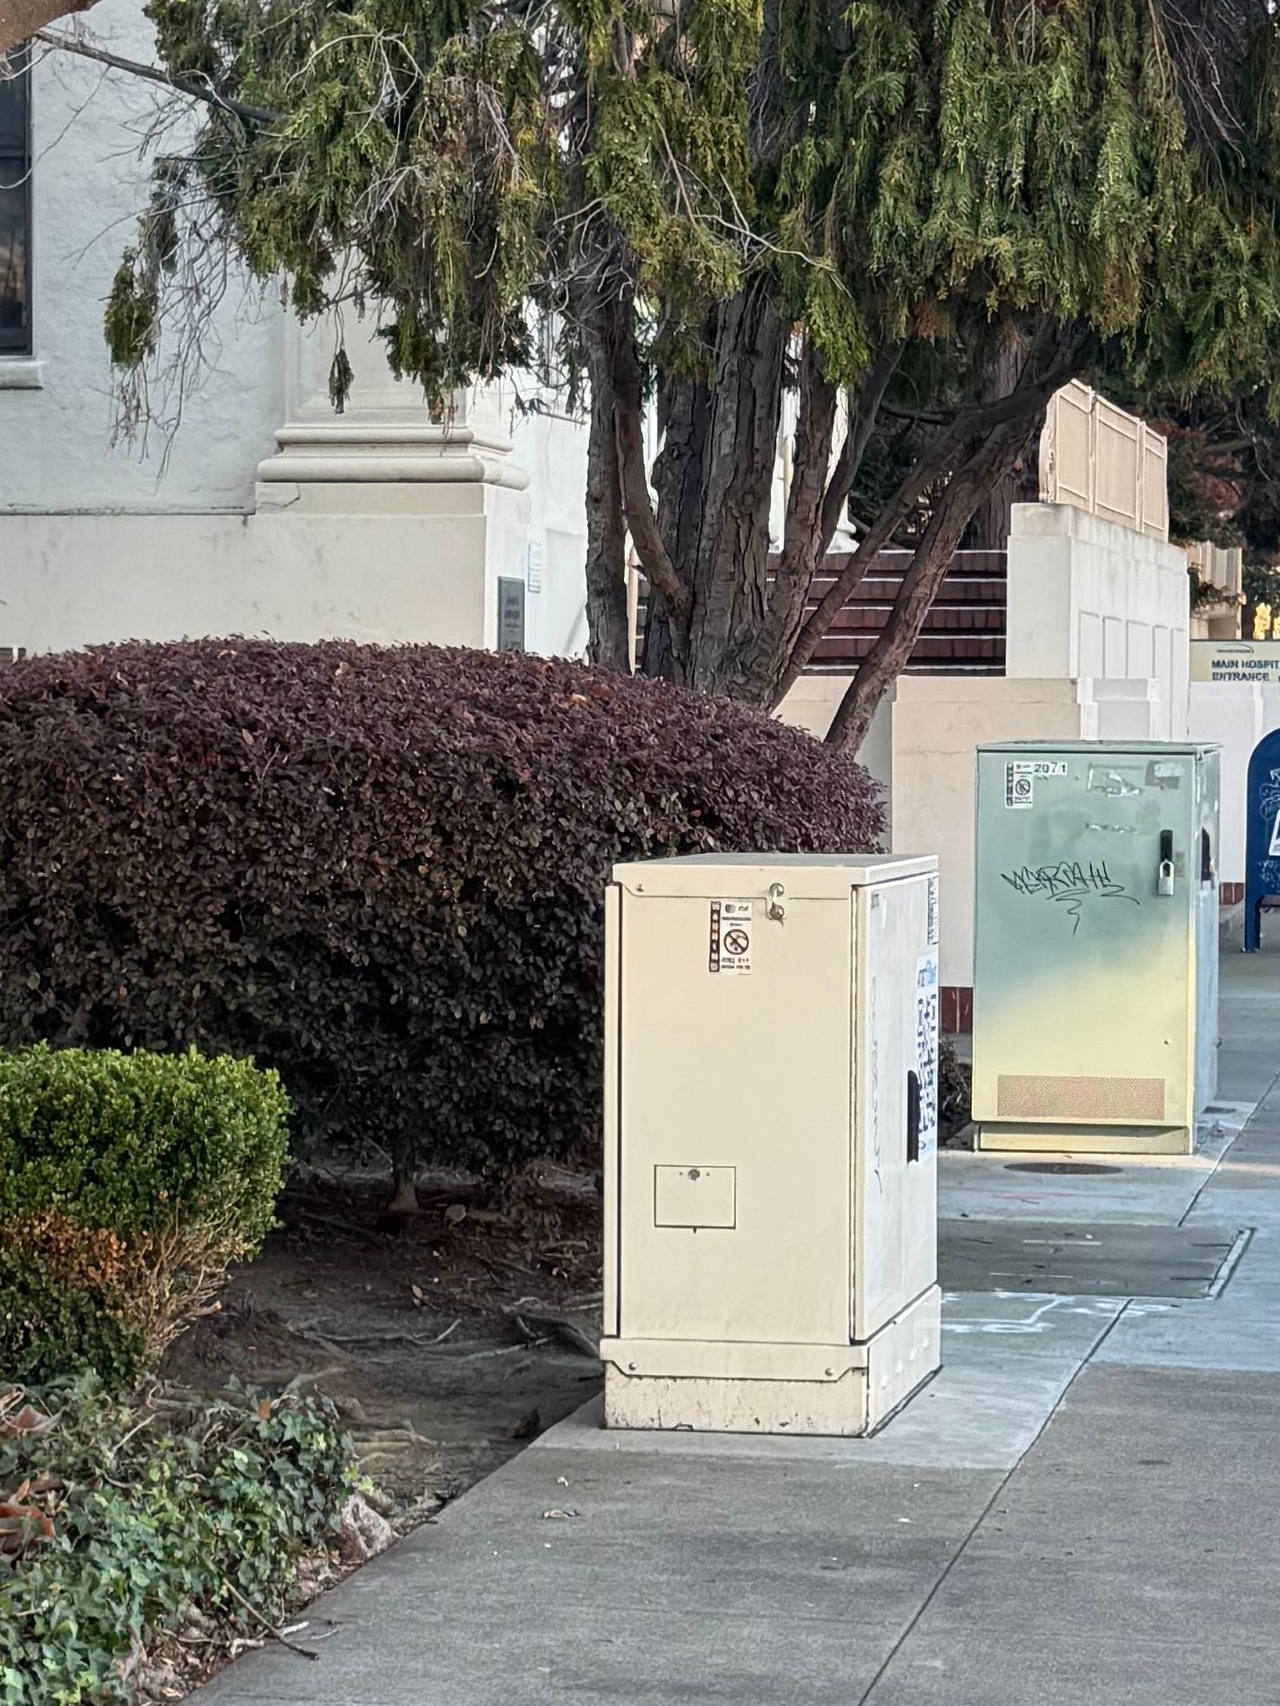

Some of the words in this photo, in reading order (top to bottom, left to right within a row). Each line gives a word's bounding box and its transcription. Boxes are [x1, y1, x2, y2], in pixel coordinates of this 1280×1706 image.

[1211, 660, 1238, 669] MAIN
[1212, 672, 1270, 681] ENTRANCE
[1034, 761, 1066, 773] 2071
